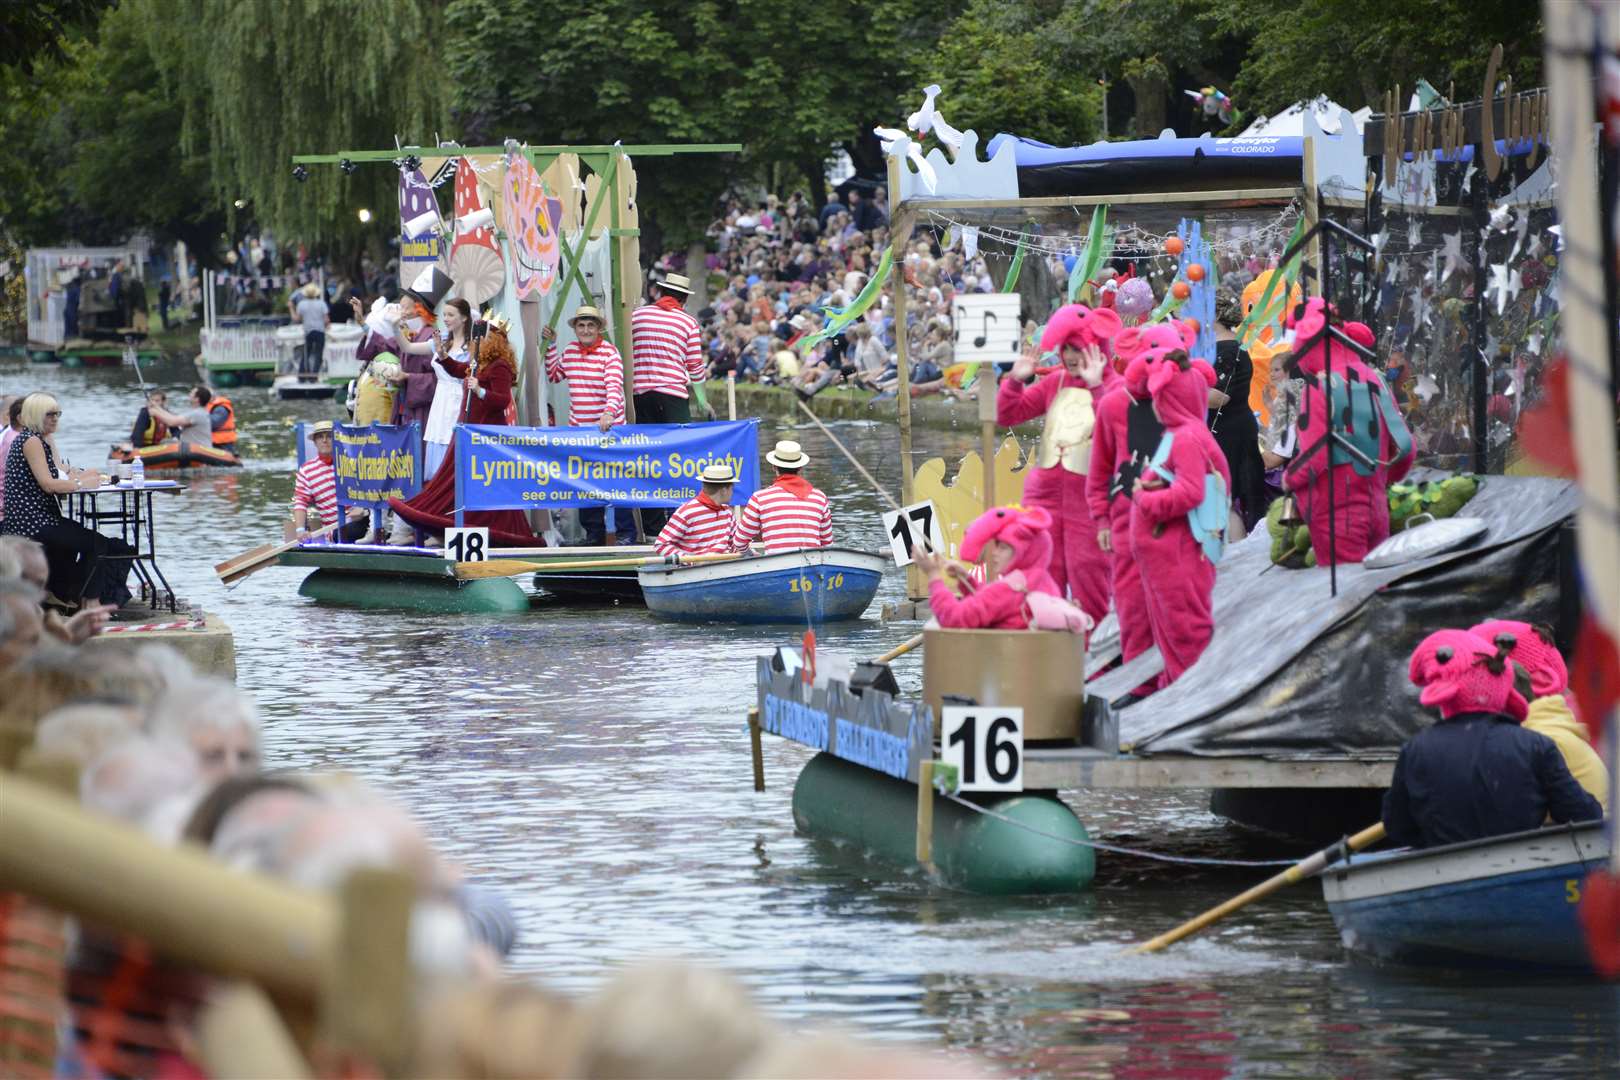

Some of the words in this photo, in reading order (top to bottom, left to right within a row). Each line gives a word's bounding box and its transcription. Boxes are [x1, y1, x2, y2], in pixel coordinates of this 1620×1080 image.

[471, 432, 547, 446] Enchanted
[552, 434, 617, 449] evenings
[620, 432, 662, 446] with...
[471, 454, 561, 486] Lyminge
[567, 453, 663, 480] Dramatic
[522, 491, 546, 501] see
[550, 490, 574, 500] our
[577, 488, 627, 500] website
[631, 487, 649, 499] for
[653, 487, 696, 499] details
[891, 505, 934, 559] 17
[448, 532, 484, 562] 18
[789, 576, 813, 593] 16
[949, 716, 1019, 784] 16
[1566, 879, 1581, 904] 5
